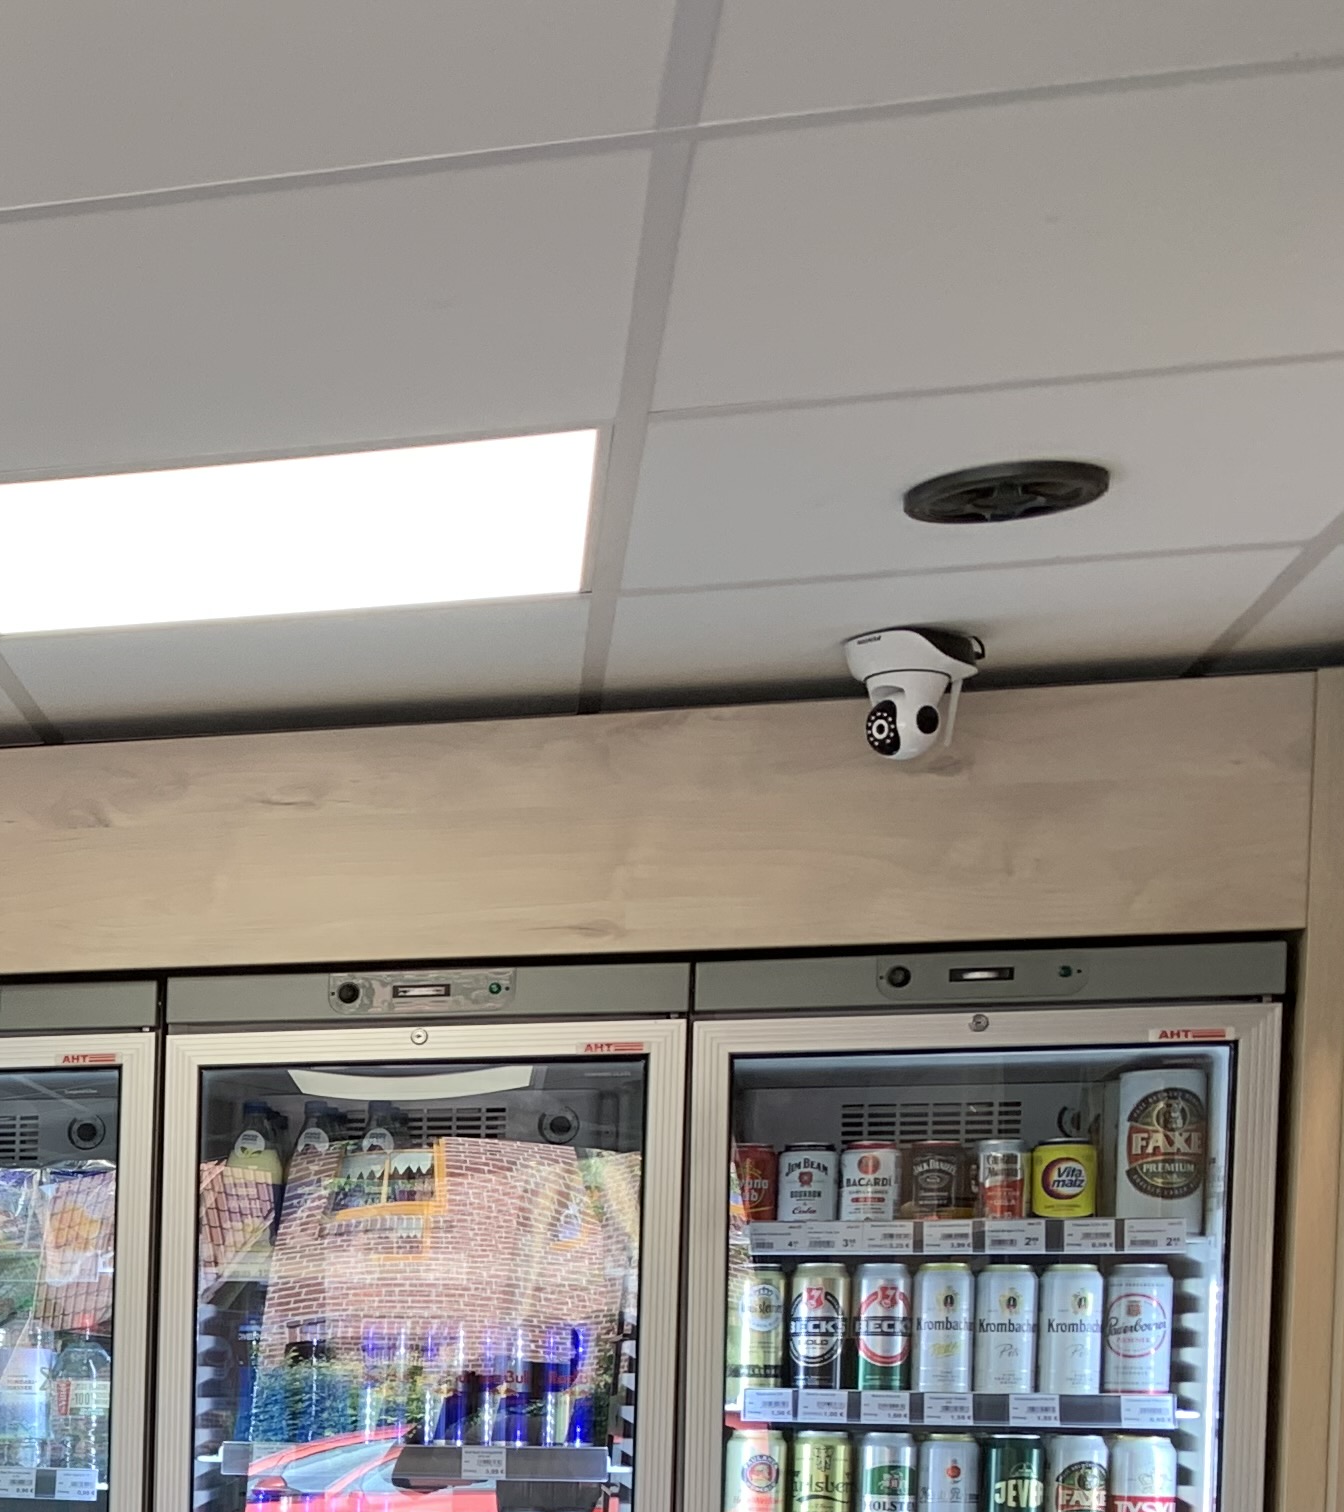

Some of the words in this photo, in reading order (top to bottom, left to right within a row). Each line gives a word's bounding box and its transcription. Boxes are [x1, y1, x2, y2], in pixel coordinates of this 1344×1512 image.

[1159, 1029, 1191, 1039] AHT
[584, 1043, 613, 1052] AHT
[62, 1055, 88, 1063] AHT
[1132, 1131, 1202, 1155] FAXE
[803, 1158, 828, 1175] BEAM
[1057, 1166, 1083, 1180] Vita
[1141, 1162, 1195, 1175] PREMIUM
[845, 1176, 893, 1188] BACARDI
[1052, 1176, 1085, 1190] malz
